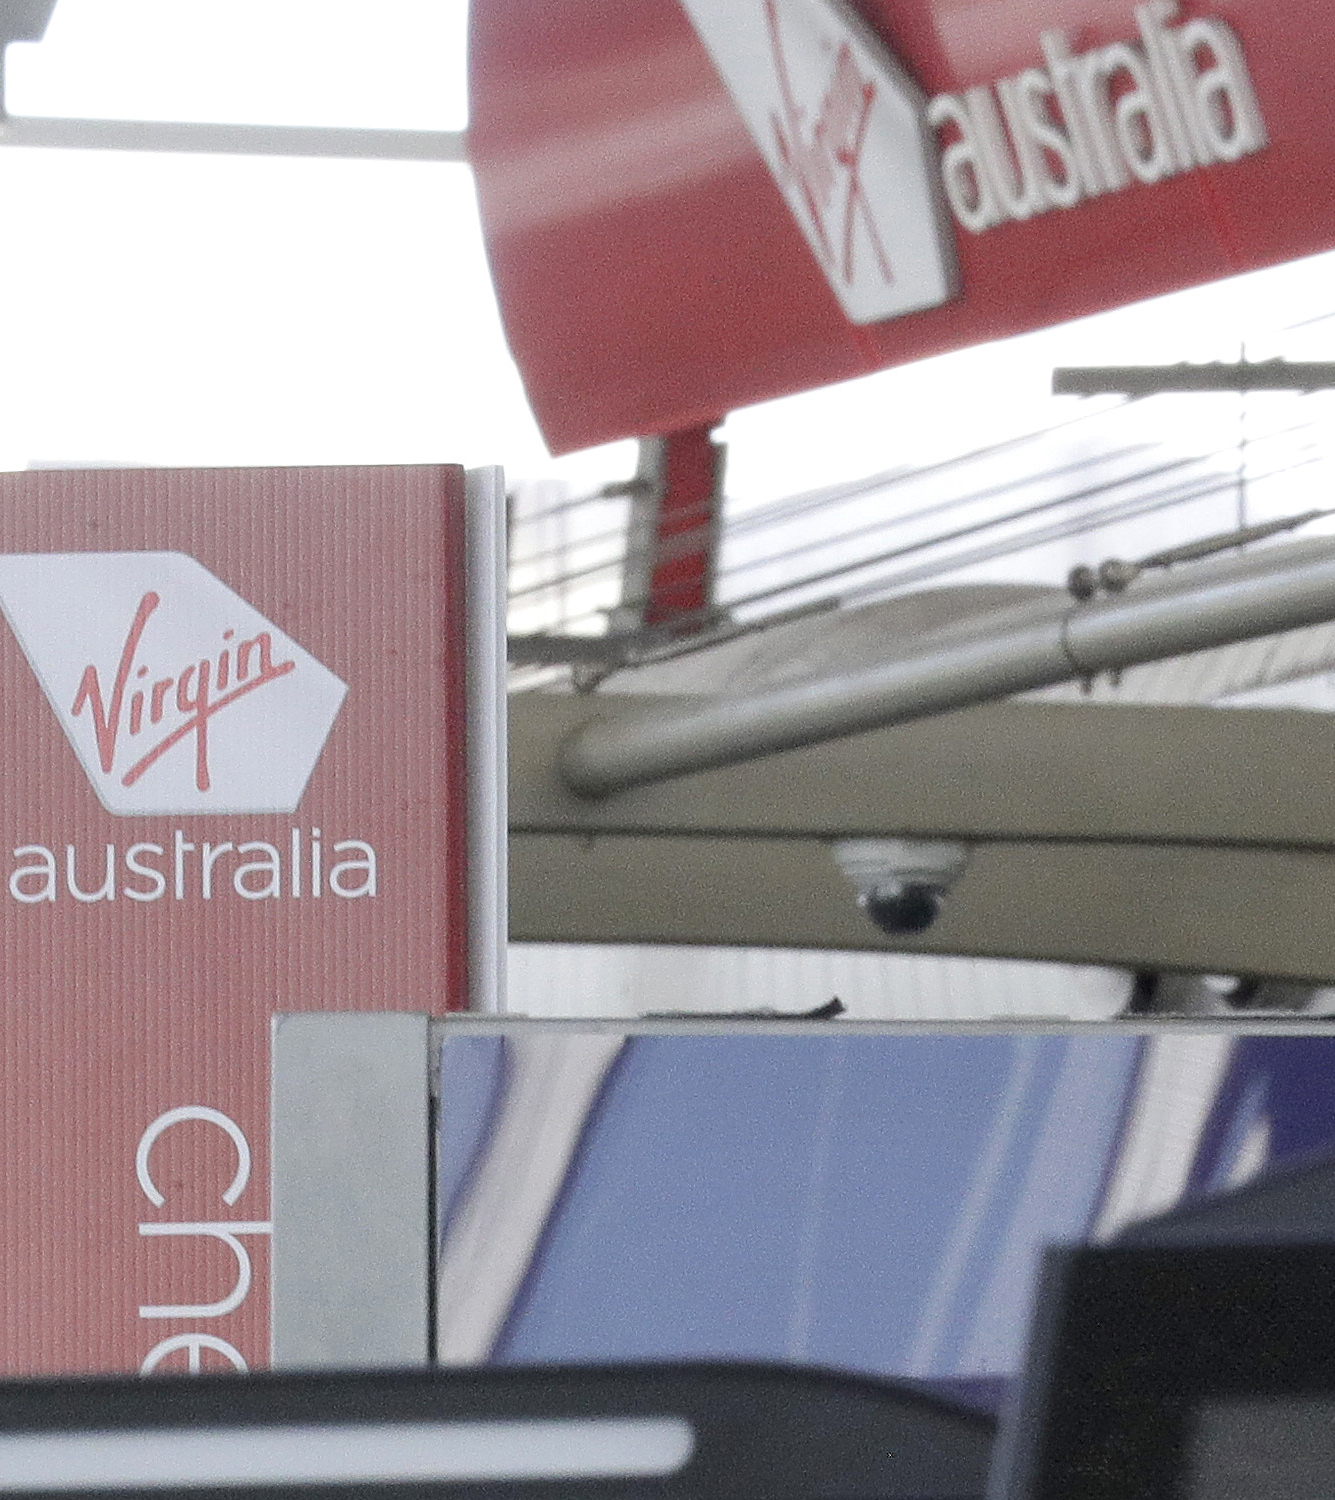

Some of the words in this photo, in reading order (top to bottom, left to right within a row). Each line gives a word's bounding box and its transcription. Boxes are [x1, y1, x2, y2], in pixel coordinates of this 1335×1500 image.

[926, 2, 1268, 234] australia
[71, 591, 296, 792] Virgin
[8, 826, 379, 903] australia
